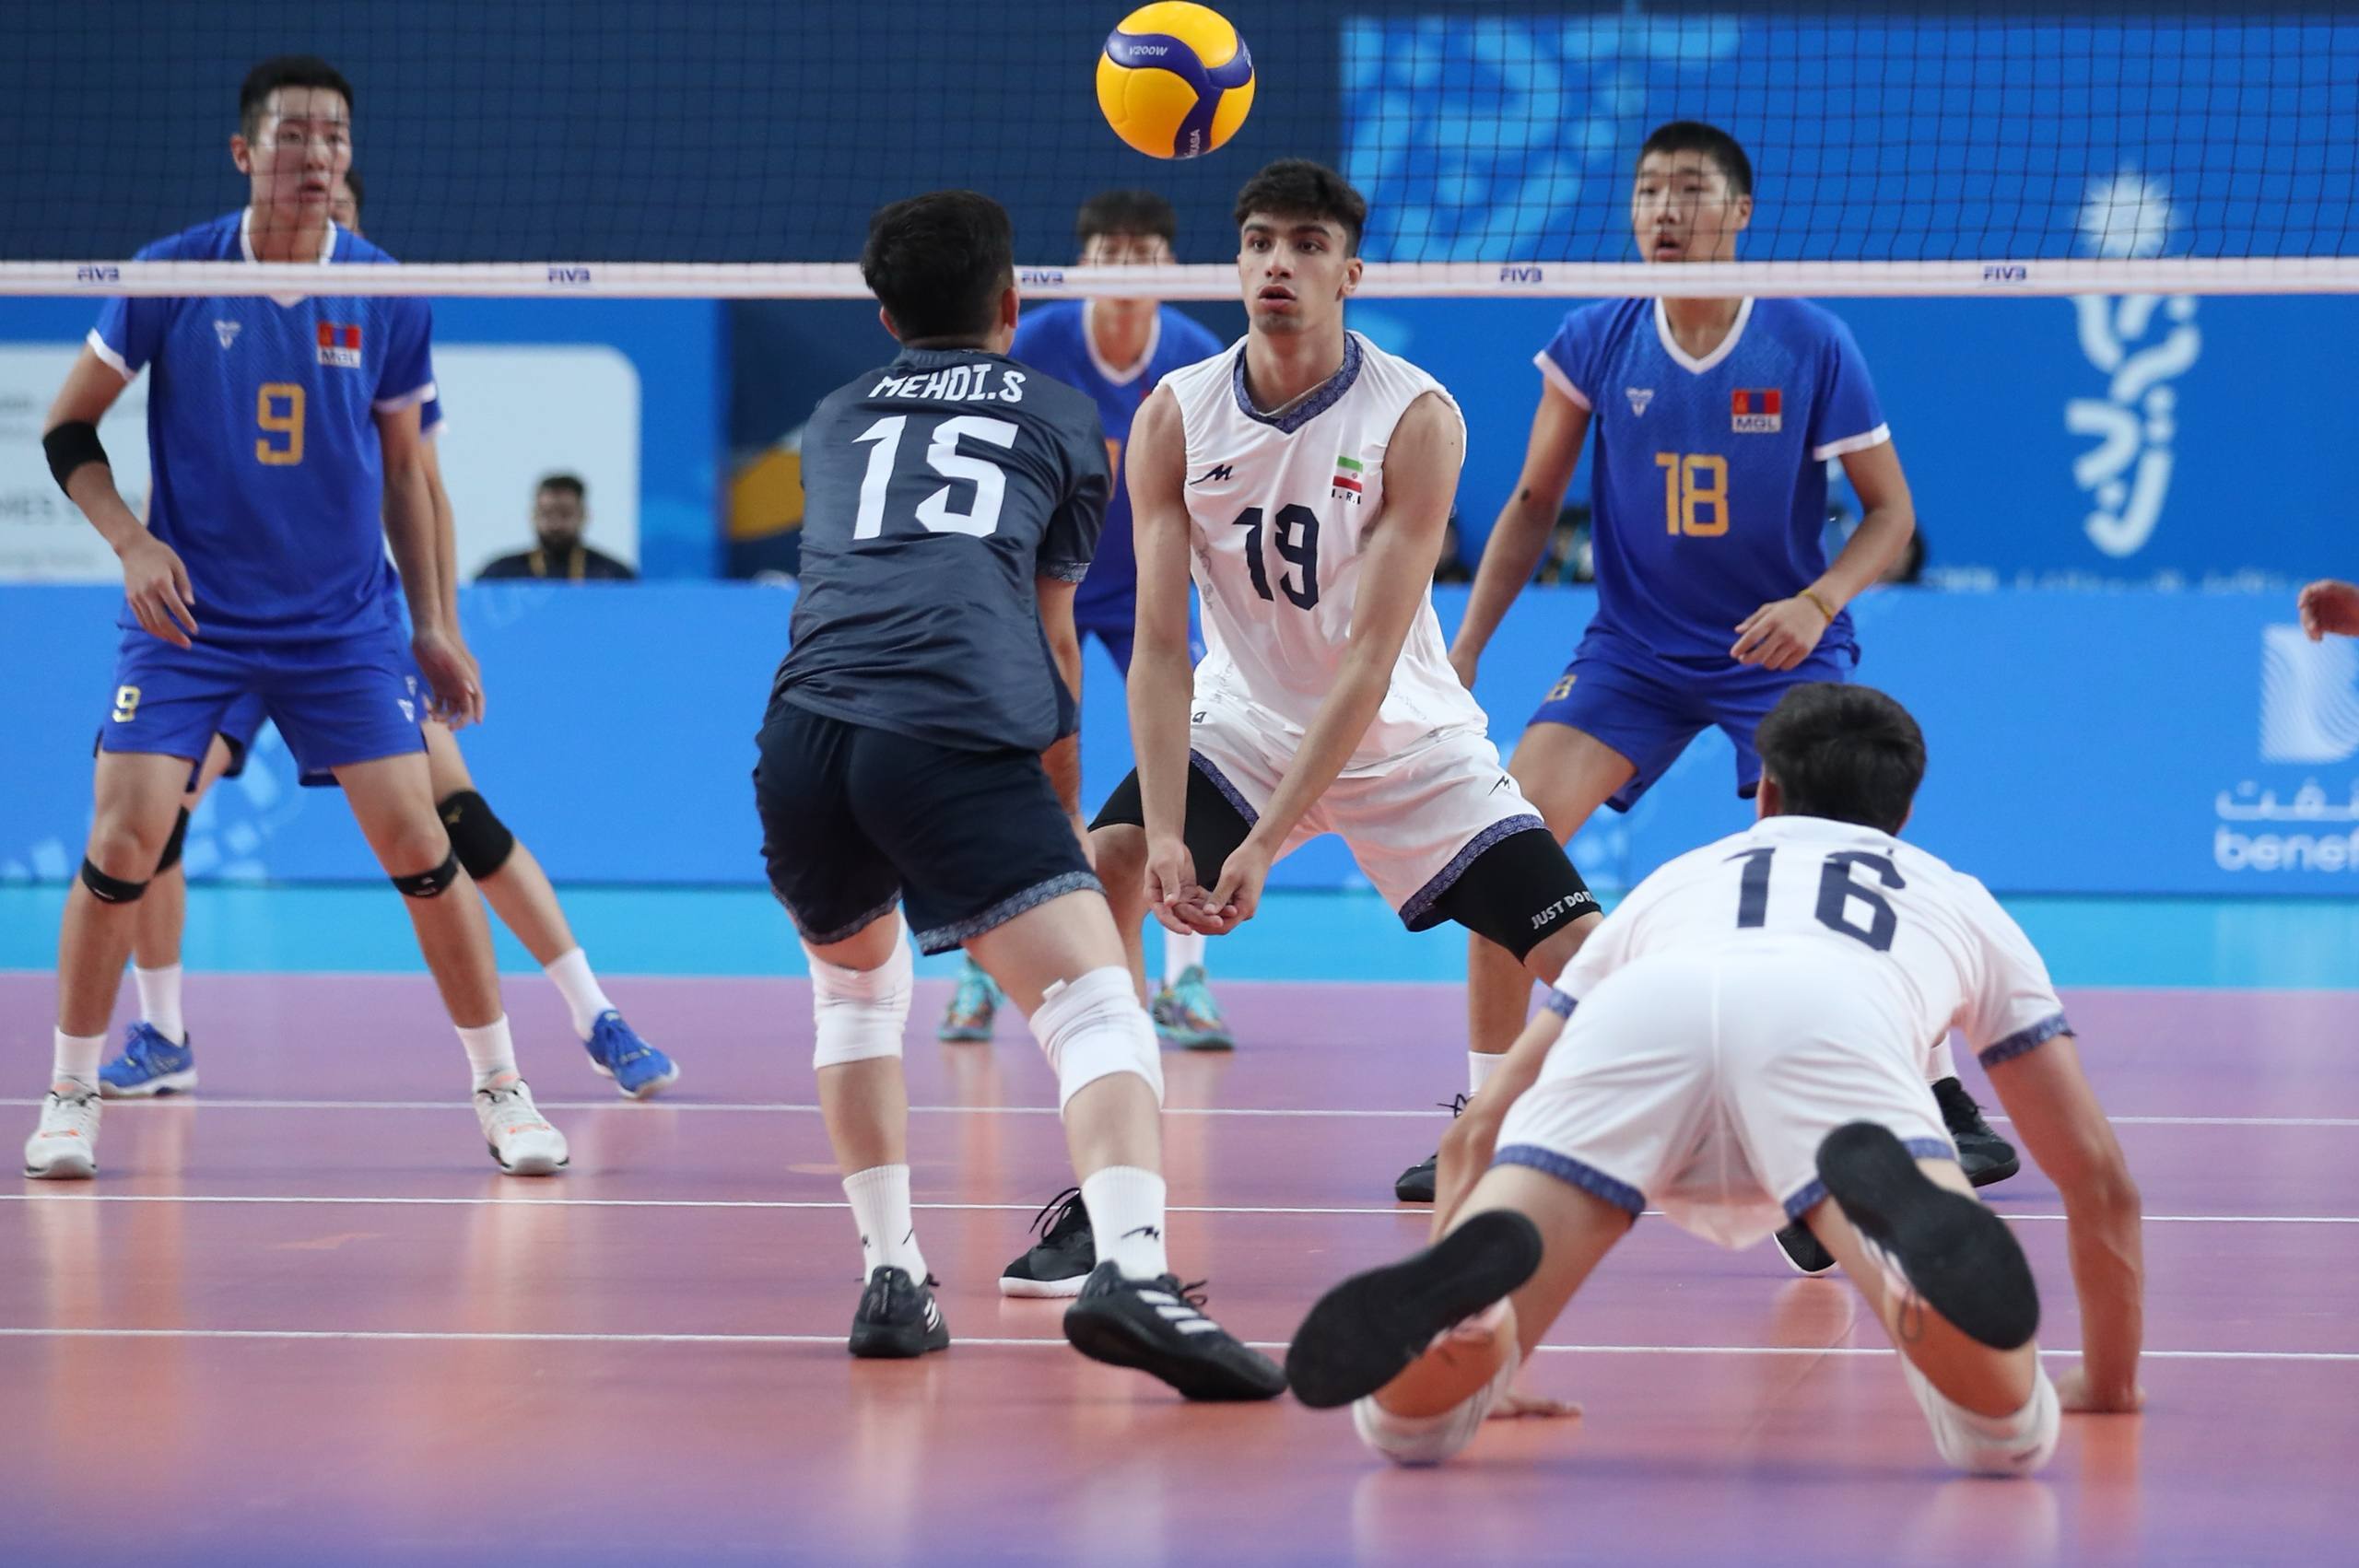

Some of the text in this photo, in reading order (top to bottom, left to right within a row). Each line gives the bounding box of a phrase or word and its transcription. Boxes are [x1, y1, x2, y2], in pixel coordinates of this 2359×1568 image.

[1129, 46, 1168, 56] V200W
[869, 364, 1027, 403] MEHDI.S
[256, 382, 305, 465] 9
[1737, 417, 1776, 429] MGL
[851, 415, 1018, 540] 15
[1656, 452, 1729, 537] 18
[1232, 504, 1320, 611] 19
[112, 685, 141, 722] 9
[1531, 901, 1565, 930] JUST
[1564, 892, 1585, 907] DO
[1721, 848, 1906, 952] 16
